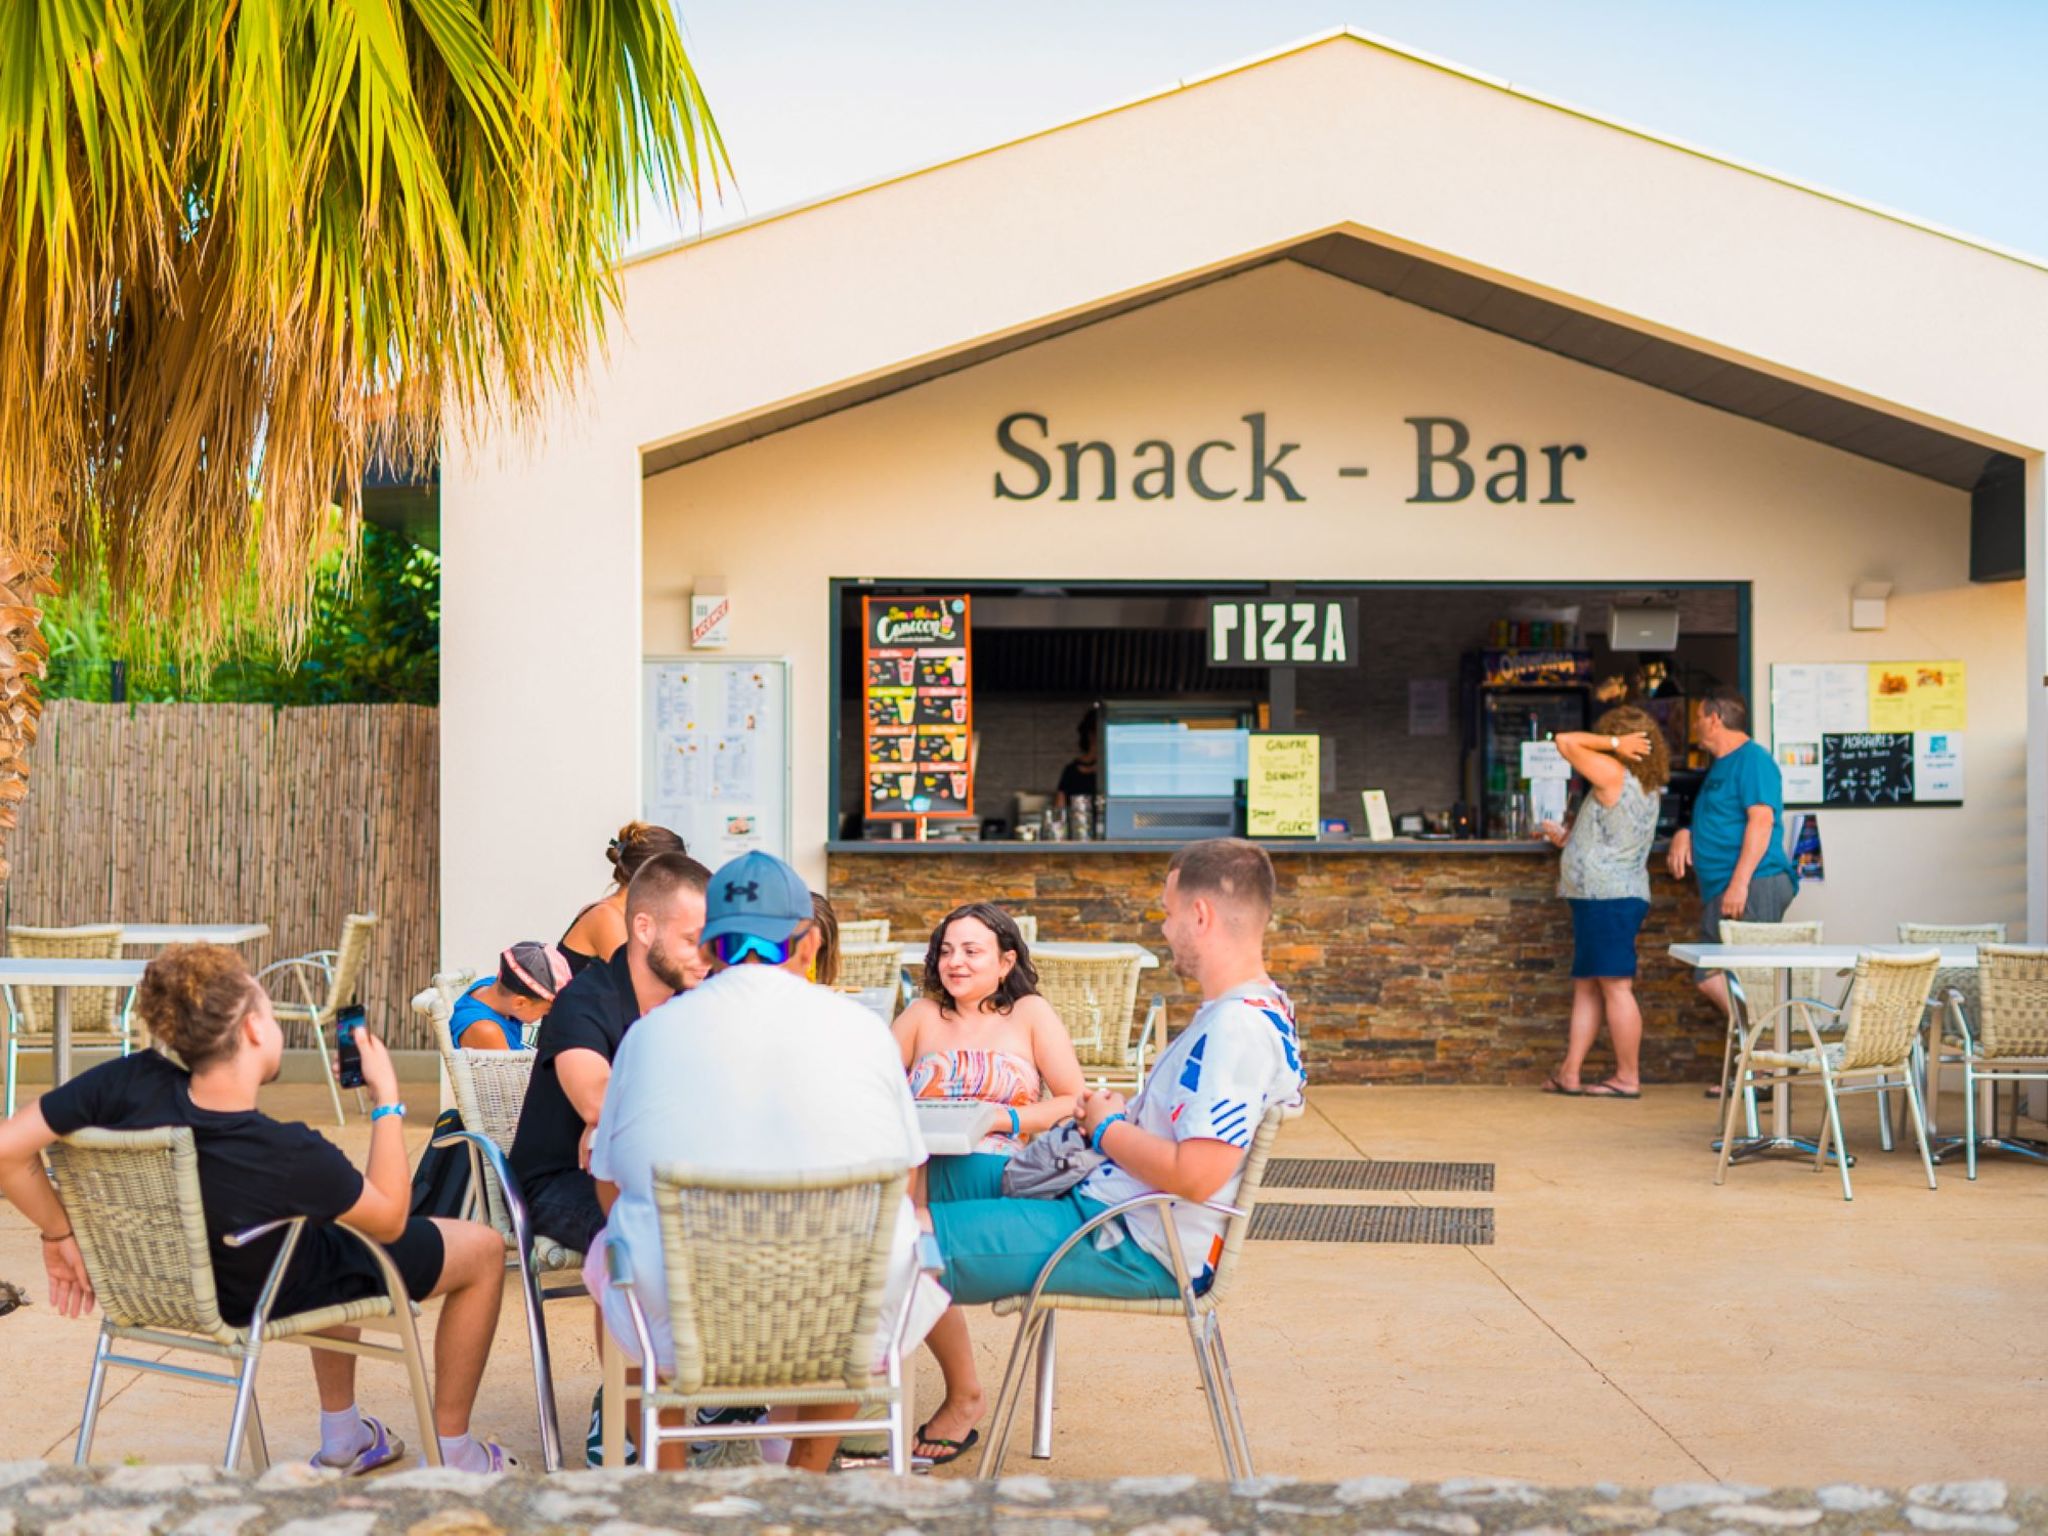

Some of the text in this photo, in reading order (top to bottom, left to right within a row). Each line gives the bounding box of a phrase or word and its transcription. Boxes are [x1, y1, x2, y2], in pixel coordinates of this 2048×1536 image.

[993, 411, 1588, 504] Snack - Bar
[1212, 602, 1347, 662] PIZZA
[1842, 734, 1895, 749] HORAIRES
